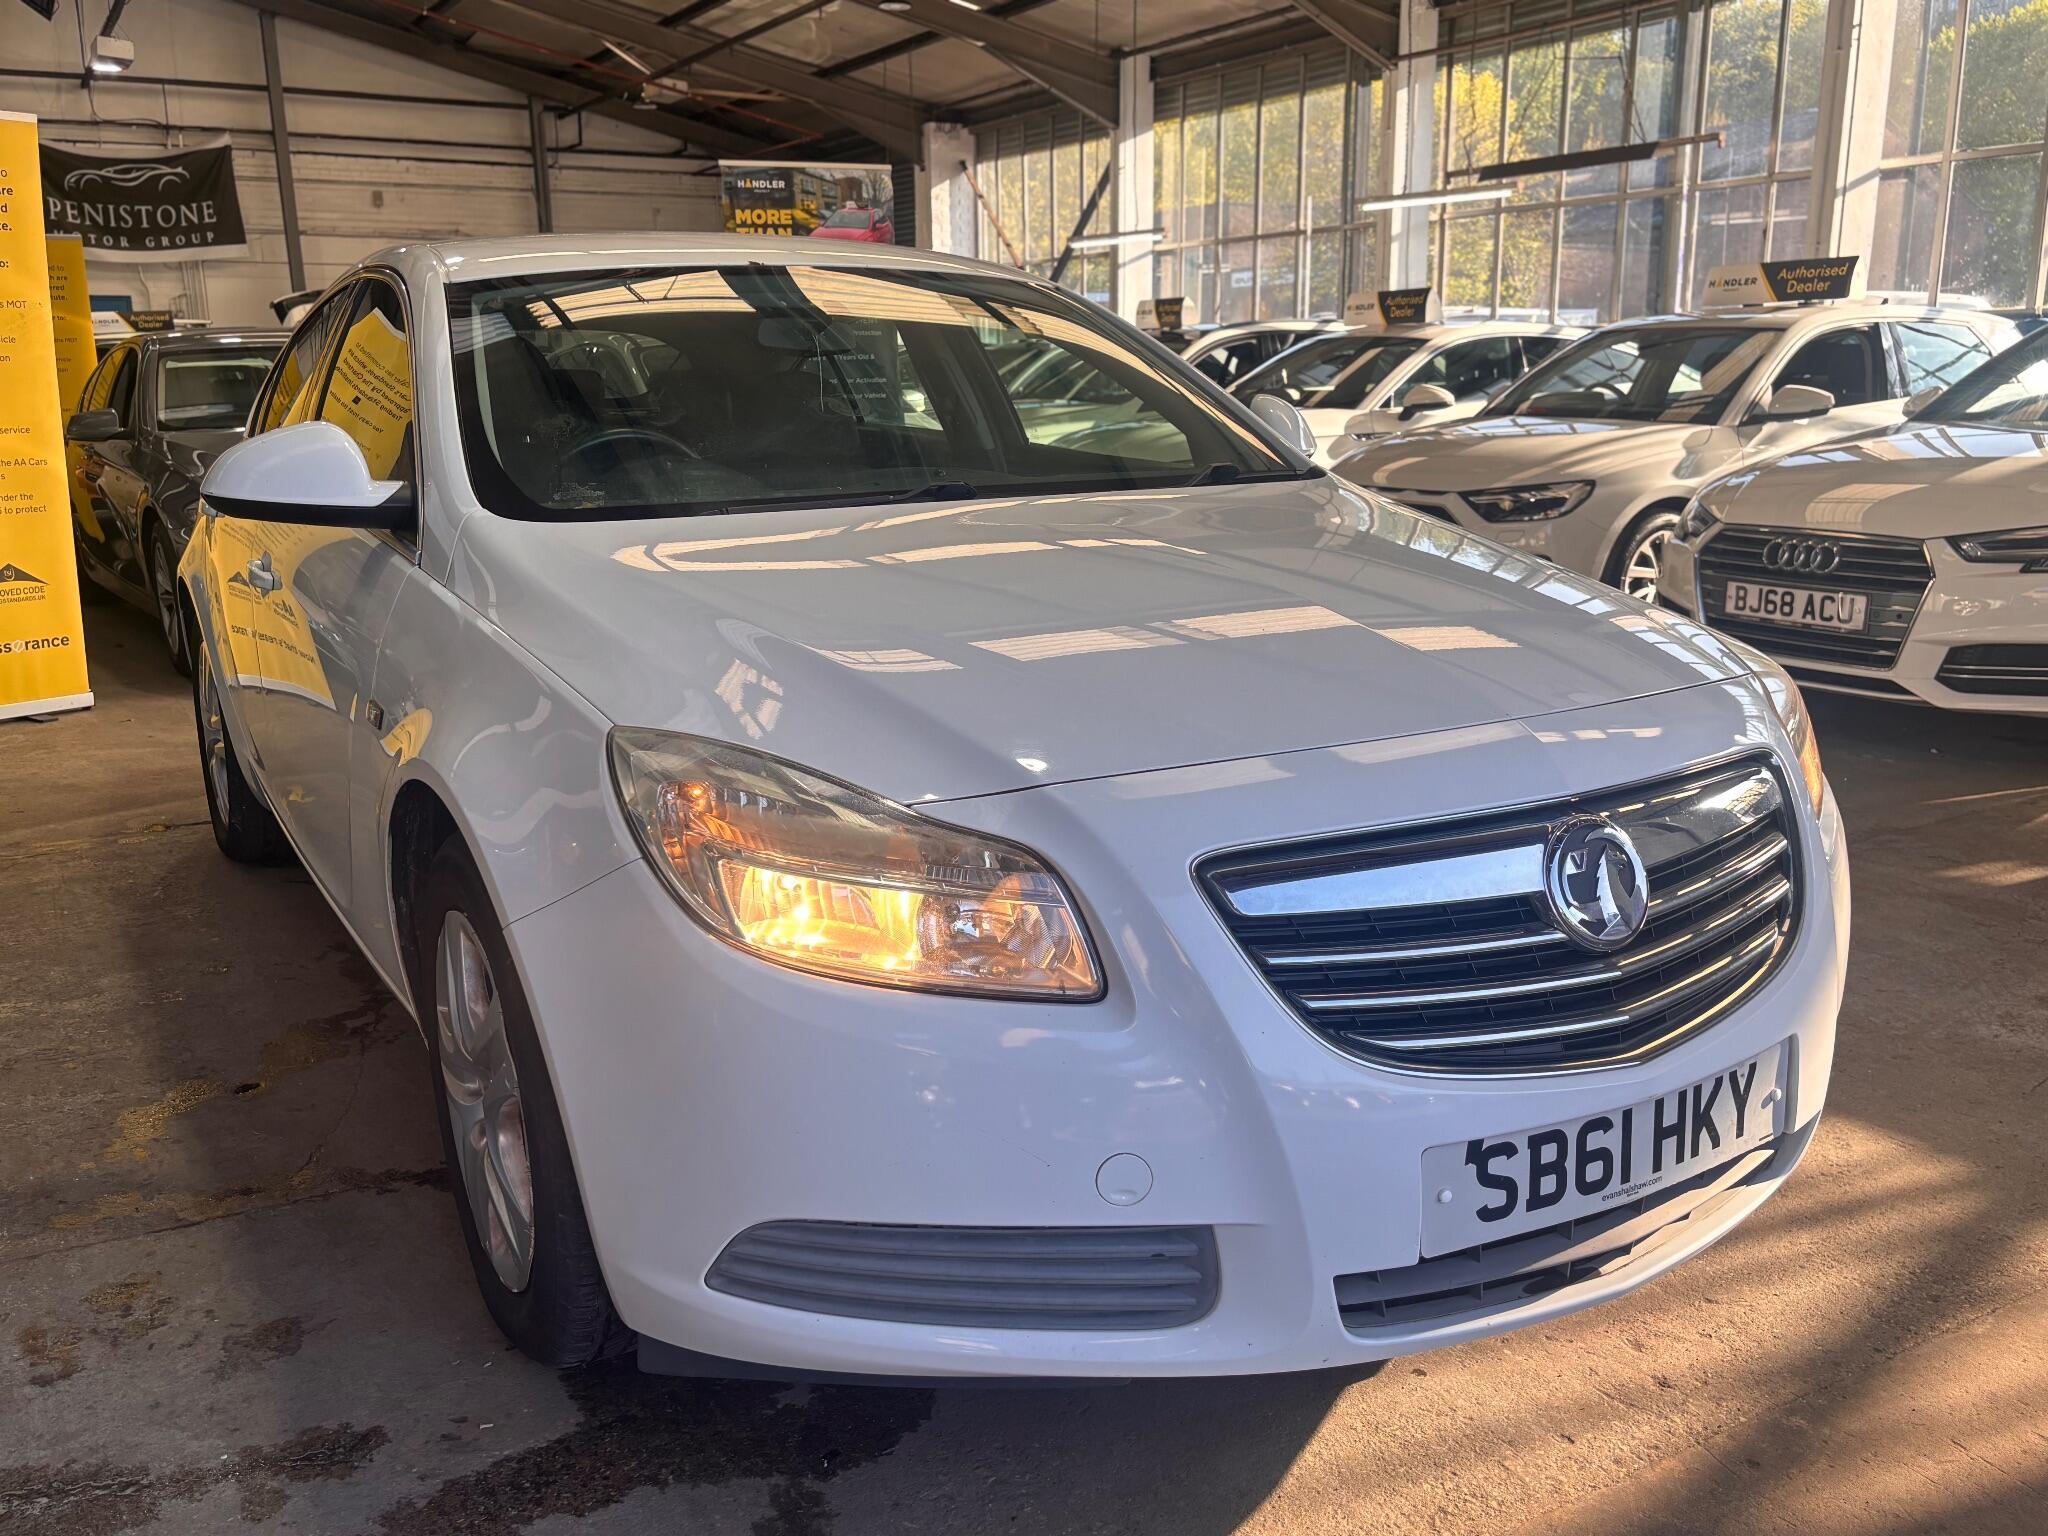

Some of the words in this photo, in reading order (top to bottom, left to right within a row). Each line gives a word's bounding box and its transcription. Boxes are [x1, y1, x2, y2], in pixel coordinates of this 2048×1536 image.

[736, 178, 786, 189] HANDLER
[47, 196, 217, 228] PENISTONE
[735, 208, 792, 224] MORE
[146, 232, 214, 248] GROUP
[1708, 276, 1758, 288] HANDLER
[1777, 262, 1848, 280] Authorised
[1786, 279, 1832, 294] Dealer
[6, 300, 28, 308] MOT
[14, 458, 26, 466] AA
[28, 458, 48, 466] Cars
[20, 492, 34, 500] the
[4, 506, 14, 514] to
[16, 504, 47, 514] protect
[22, 586, 46, 595] CODE
[1734, 585, 1794, 616] BJ68
[1802, 592, 1854, 624] ACU
[1465, 1108, 1633, 1223] SB61
[1652, 1061, 1758, 1174] HKY
[1601, 1176, 1662, 1202] evanshalshaw.com
